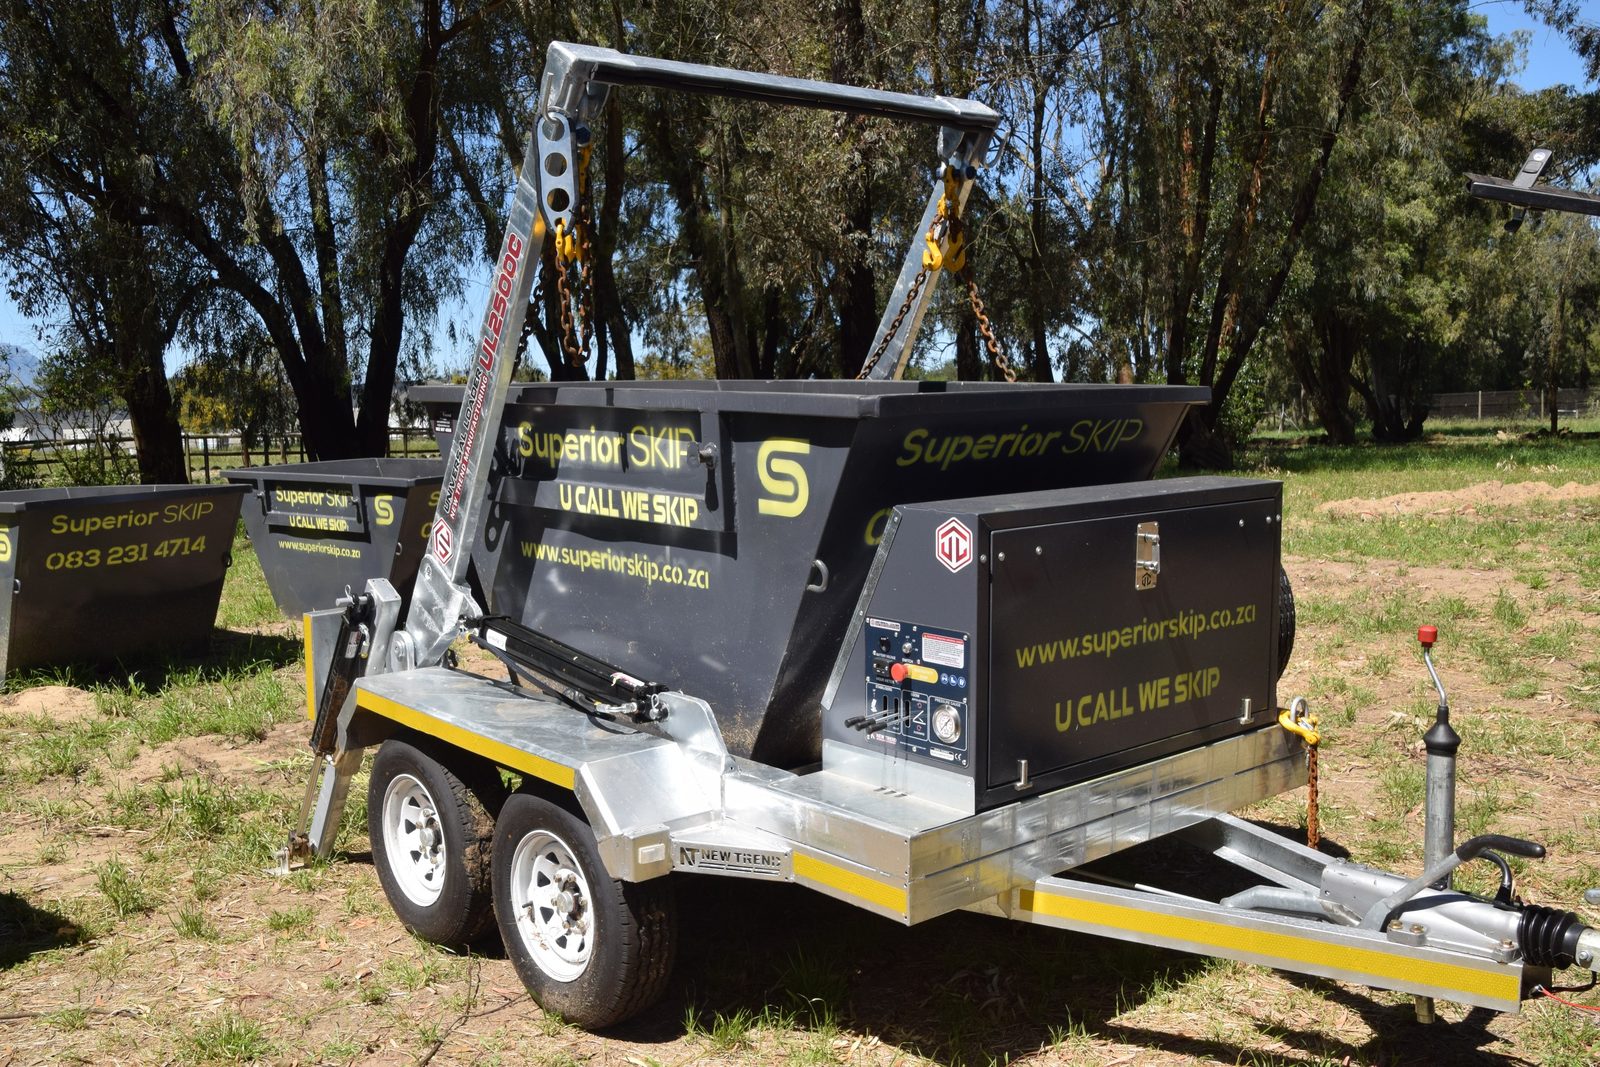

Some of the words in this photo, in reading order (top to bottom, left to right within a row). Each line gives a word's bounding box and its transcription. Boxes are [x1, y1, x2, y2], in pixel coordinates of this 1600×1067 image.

[443, 431, 467, 514] UNIVERSAL
[463, 367, 483, 430] LOADER
[449, 497, 459, 520] NEW
[455, 462, 468, 499] TREND
[464, 374, 488, 463] MANUFACTURING
[518, 421, 625, 468] Superior
[630, 425, 697, 469] SKIP
[896, 424, 1062, 471] Superior
[1062, 419, 1143, 454] SKIP
[275, 485, 324, 507] Superior
[559, 484, 573, 511] U
[575, 486, 619, 518] CALL
[621, 490, 650, 521] WE
[653, 494, 698, 527] SKIP
[51, 510, 159, 536] Superior
[163, 502, 213, 523] SKIP
[289, 515, 296, 528] U
[296, 515, 316, 529] CALL
[316, 517, 329, 530] WE
[329, 518, 347, 531] SKIP
[46, 549, 101, 570] 083
[107, 543, 148, 565] 231
[154, 535, 207, 558] 4714
[278, 540, 360, 558] www.superiorskip.co.za
[520, 541, 709, 589] www.superiorskip.co.za
[1016, 604, 1256, 668] www.superiorskip.co.za
[1055, 700, 1072, 732] U
[1077, 687, 1134, 727] CALL
[1139, 677, 1170, 712] WE
[1174, 666, 1221, 703] SKIP
[701, 848, 731, 861] NEW
[734, 852, 781, 867] TREND
